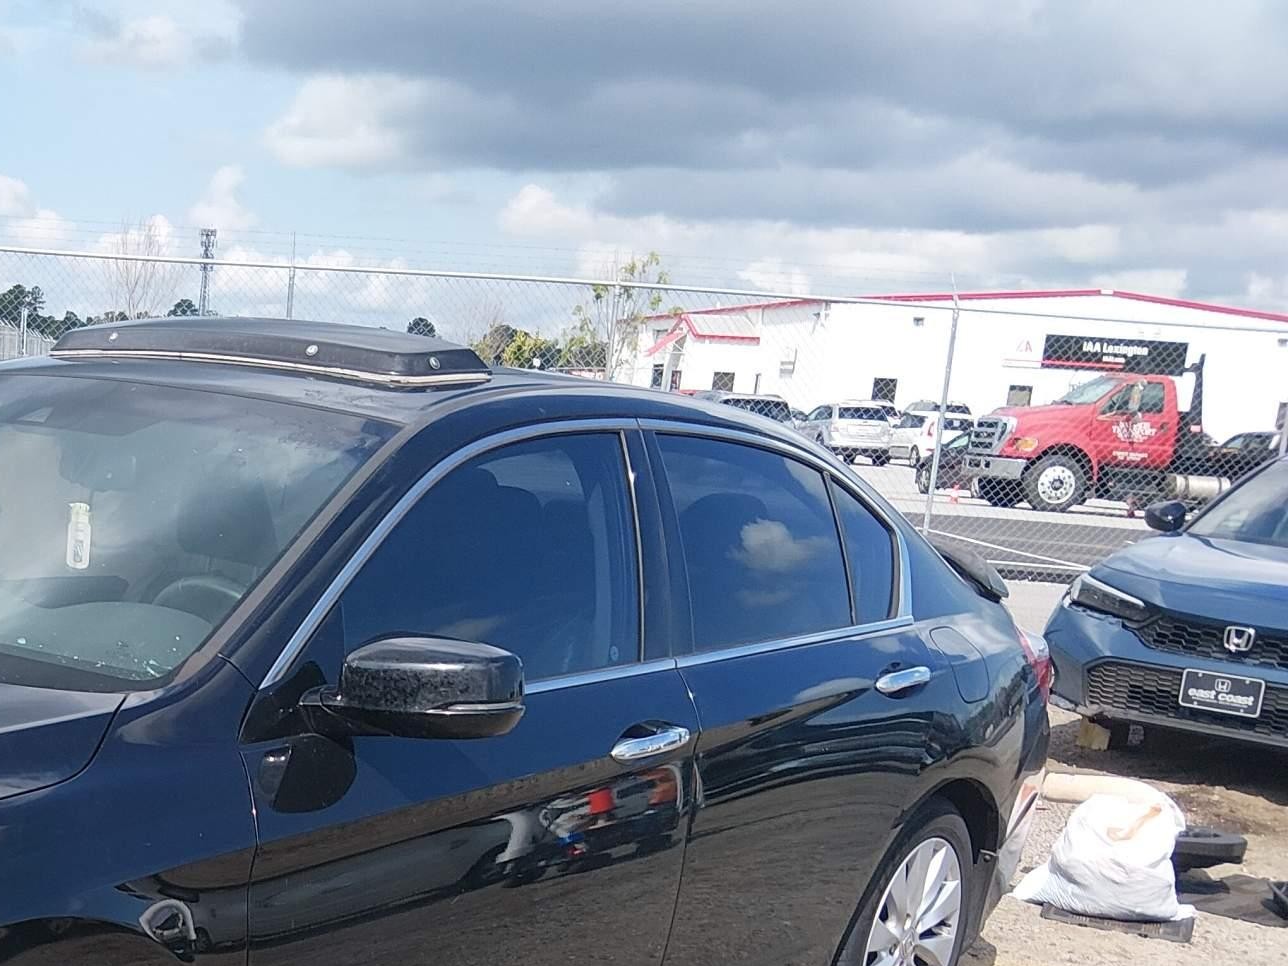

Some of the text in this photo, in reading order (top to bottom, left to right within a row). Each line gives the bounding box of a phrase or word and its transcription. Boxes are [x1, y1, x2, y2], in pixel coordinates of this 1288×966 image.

[1082, 341, 1149, 357] IAA Lexington
[1188, 688, 1216, 699] east
[1218, 693, 1254, 706] coast
